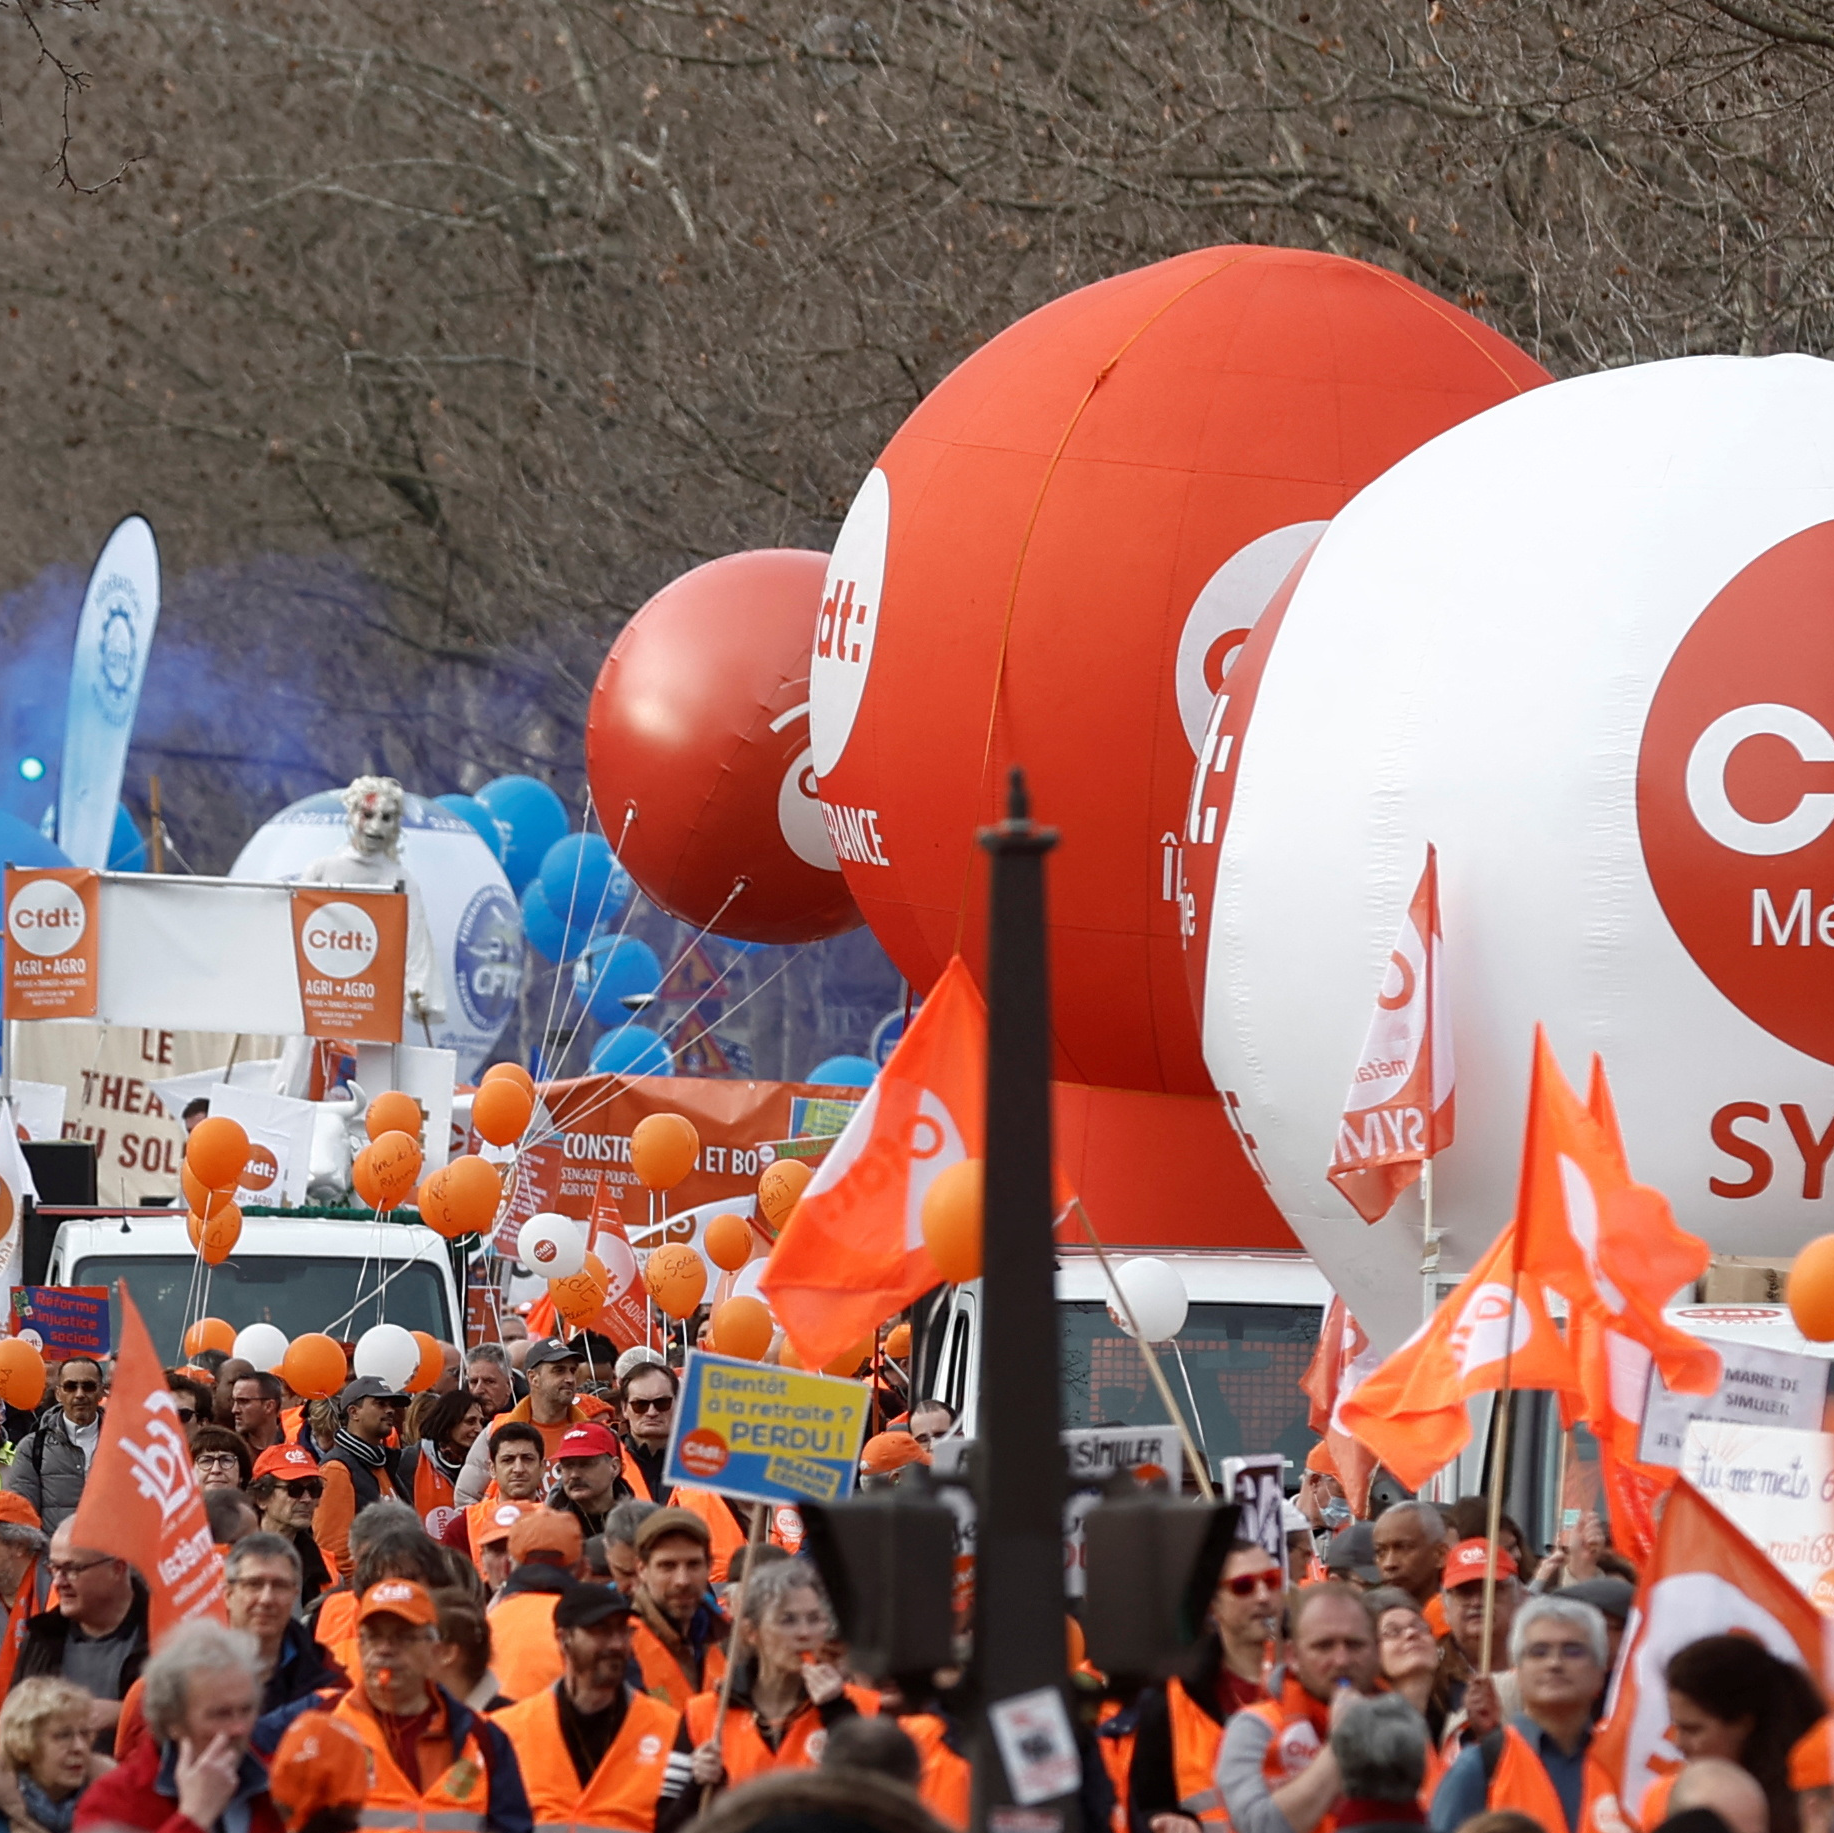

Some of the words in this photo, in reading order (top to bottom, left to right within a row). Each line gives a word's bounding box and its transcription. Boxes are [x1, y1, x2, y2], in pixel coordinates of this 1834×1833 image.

[817, 578, 868, 663] dt:
[15, 907, 79, 929] Cfdt:
[308, 929, 372, 952] Cfdt:
[13, 960, 43, 976] AGRI
[53, 958, 87, 975] AGRO
[305, 979, 333, 996] AGRI
[343, 982, 375, 999] AGRO
[141, 1028, 174, 1065] LE
[80, 1070, 177, 1120] THEA
[118, 1132, 185, 1175] SOL
[706, 1146, 728, 1173] ET
[732, 1150, 757, 1176] BO
[34, 1291, 99, 1314] Réforme
[49, 1329, 100, 1347] sociale
[709, 1371, 788, 1395] Bientôt
[706, 1394, 721, 1414] à
[726, 1399, 746, 1415] la
[750, 1402, 835, 1422] retraite
[841, 1406, 855, 1424] ?
[1725, 1392, 1791, 1416] SIMULER
[730, 1421, 832, 1452] PERDU
[837, 1430, 845, 1455] !
